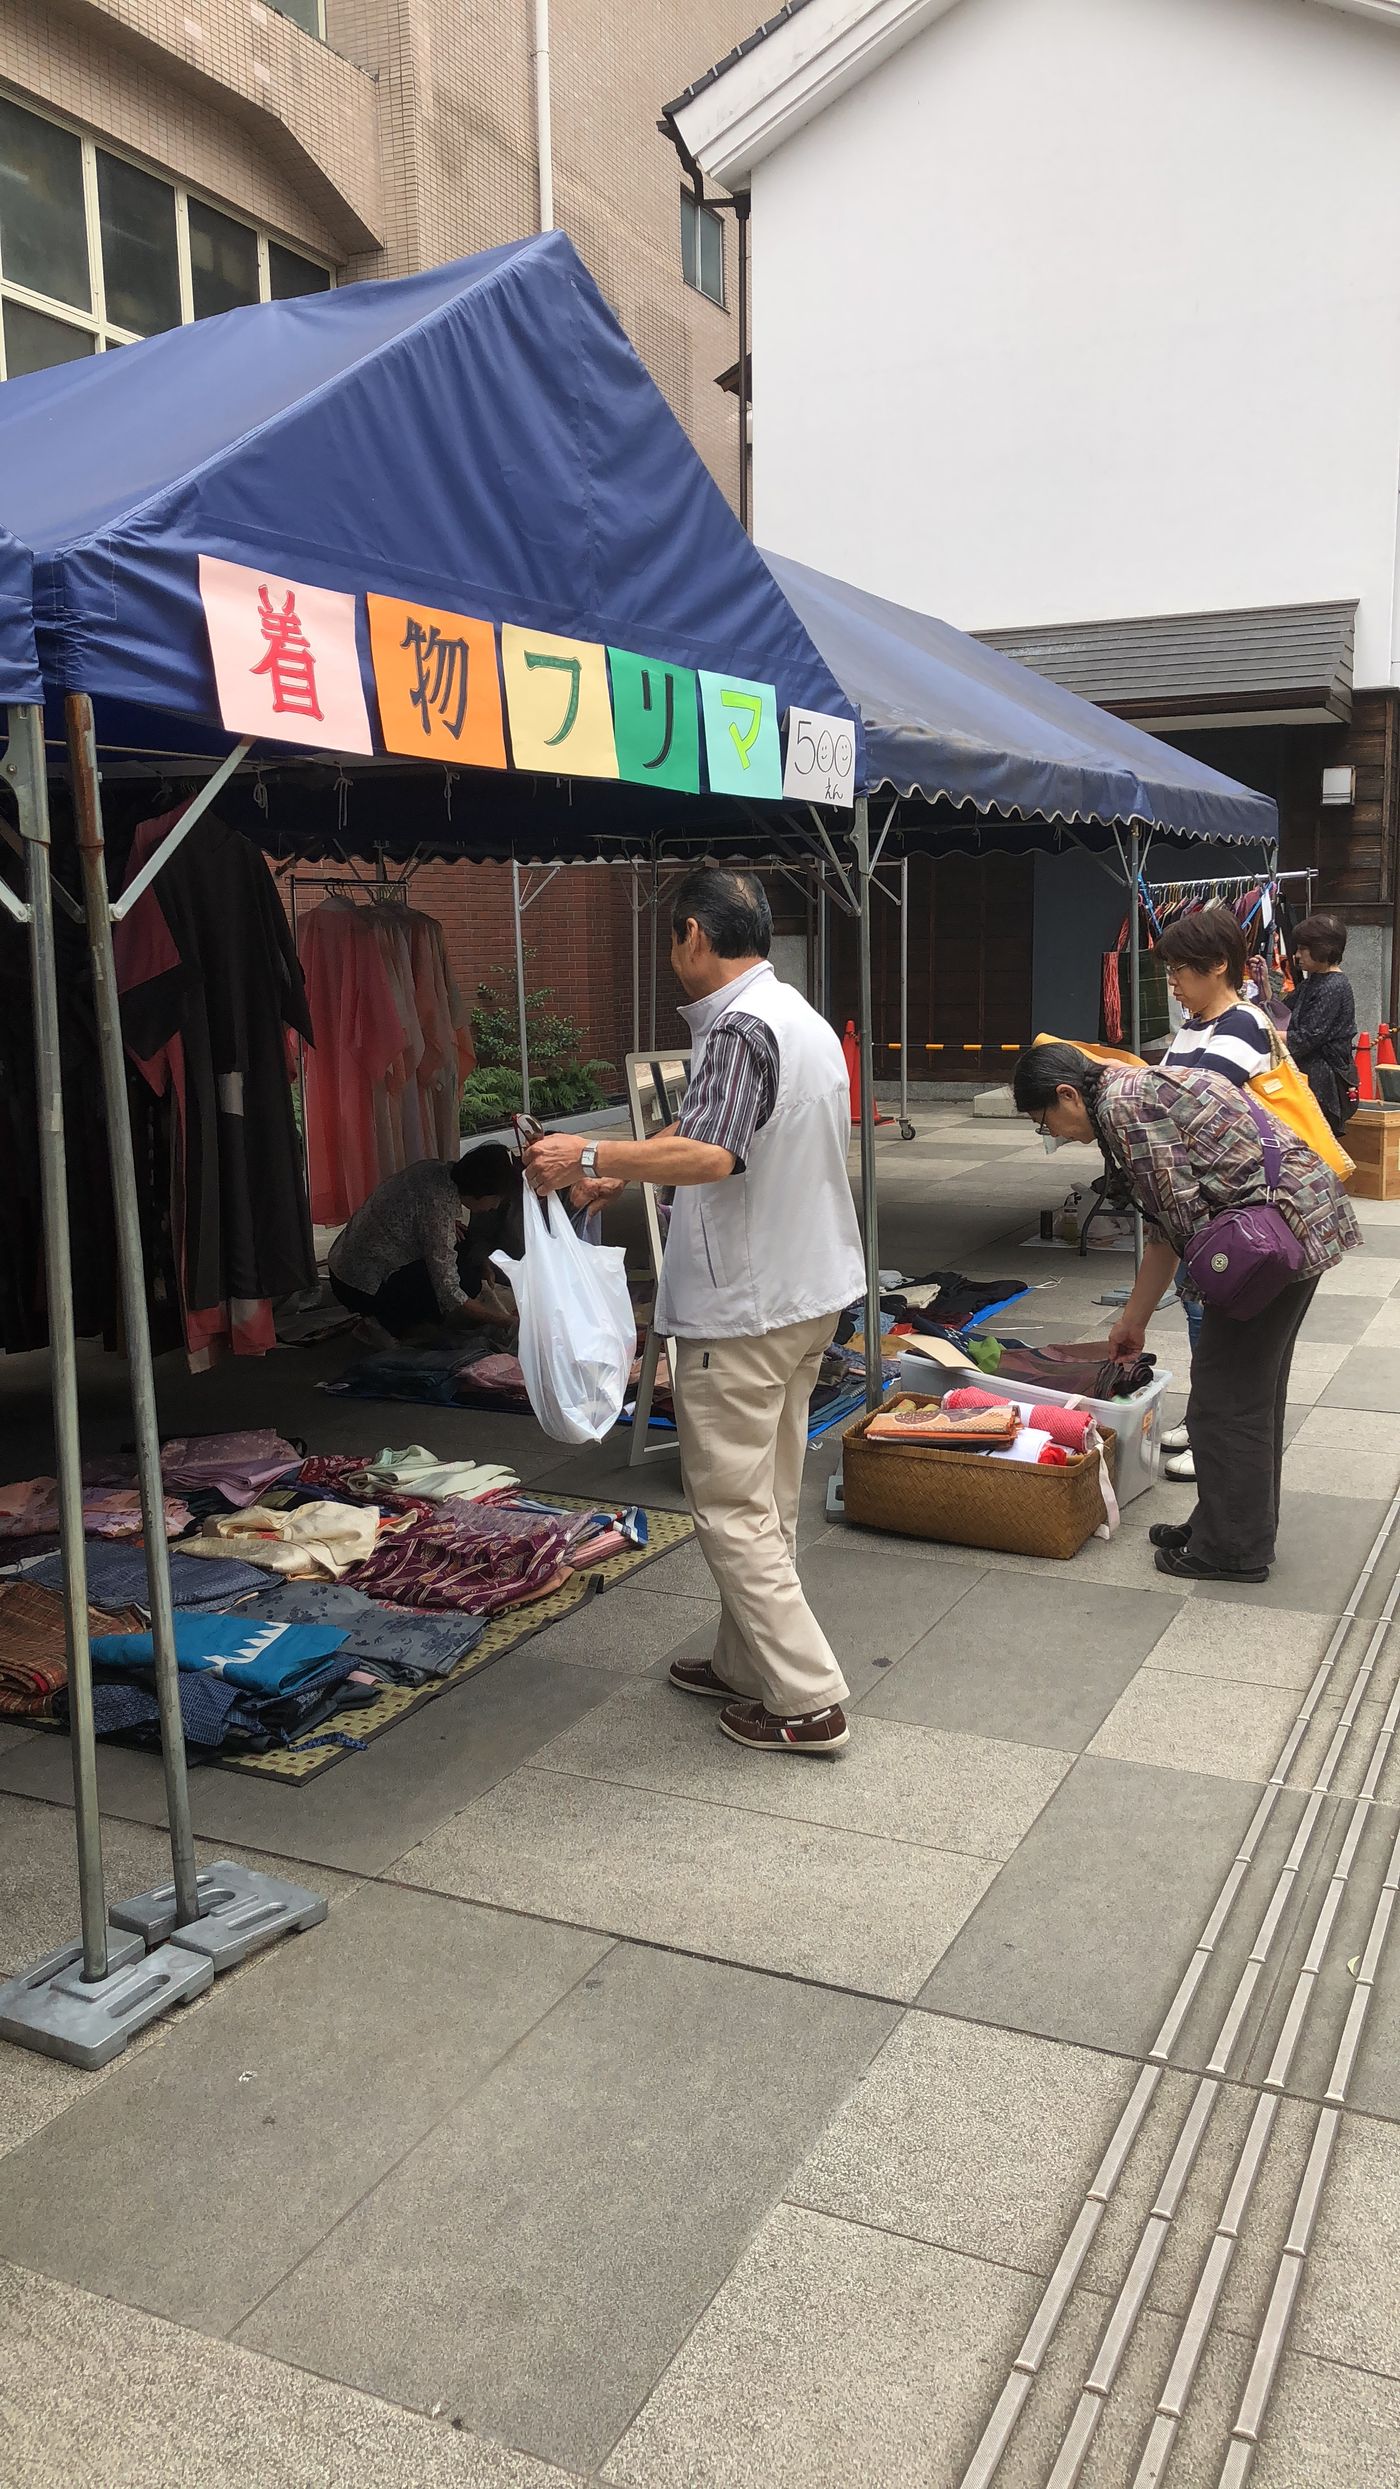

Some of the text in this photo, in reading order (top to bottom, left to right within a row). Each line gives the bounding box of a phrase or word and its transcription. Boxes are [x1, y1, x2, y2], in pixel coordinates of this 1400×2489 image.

[249, 583, 763, 770] 着物フリマ
[795, 721, 853, 777] 500
[825, 777, 844, 799] えん
